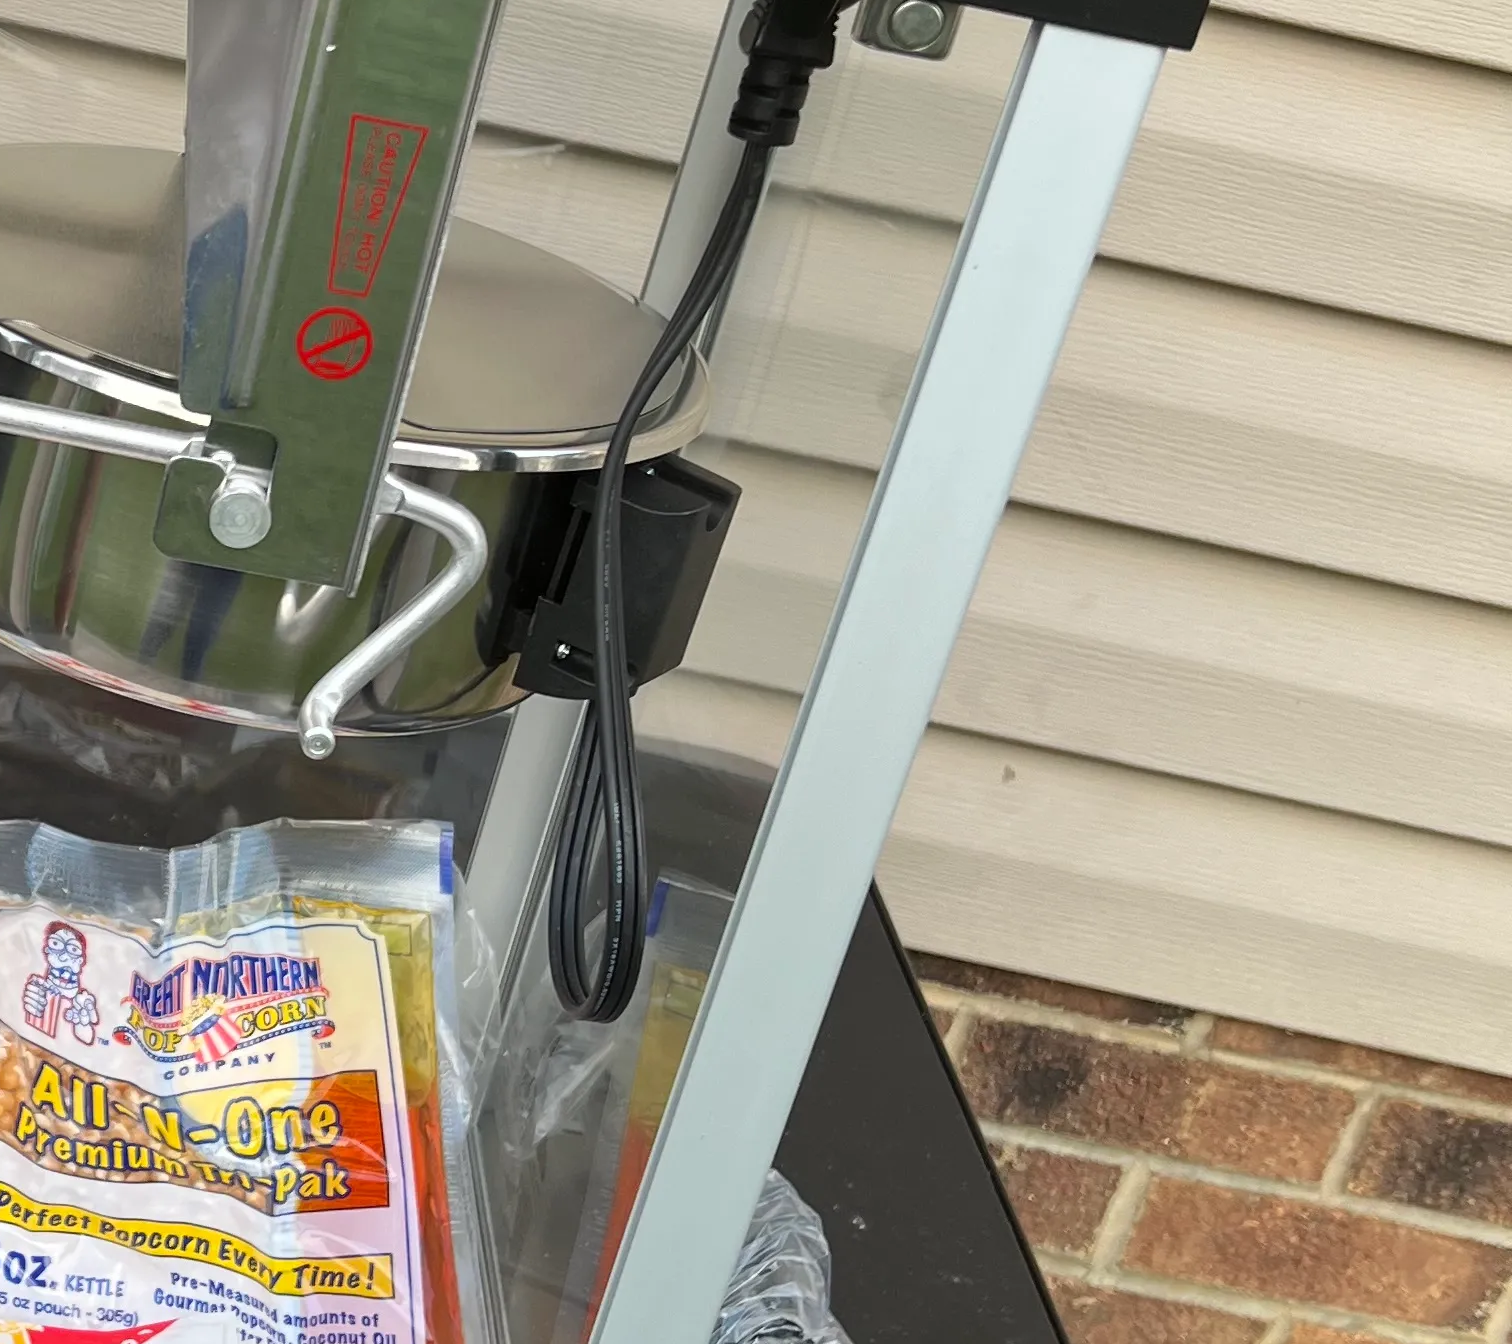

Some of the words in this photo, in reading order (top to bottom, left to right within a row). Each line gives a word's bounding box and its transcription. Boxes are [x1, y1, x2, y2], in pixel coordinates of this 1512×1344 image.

[355, 232, 376, 274] HOT
[131, 960, 188, 1018] GREAT
[236, 996, 328, 1039] CORN
[163, 1052, 276, 1080] COMPANY
[30, 1061, 344, 1160] All-N-One
[14, 1101, 189, 1178] Premium
[99, 1219, 210, 1256] Popcorn
[217, 1238, 284, 1290] Every
[291, 1262, 375, 1291] Time!
[64, 1273, 125, 1298] KETTLE
[11, 1297, 30, 1310] oz
[33, 1299, 81, 1318] pouch
[96, 1307, 139, 1327] 305g)
[283, 1312, 356, 1329] amounts
[361, 1312, 380, 1328] of
